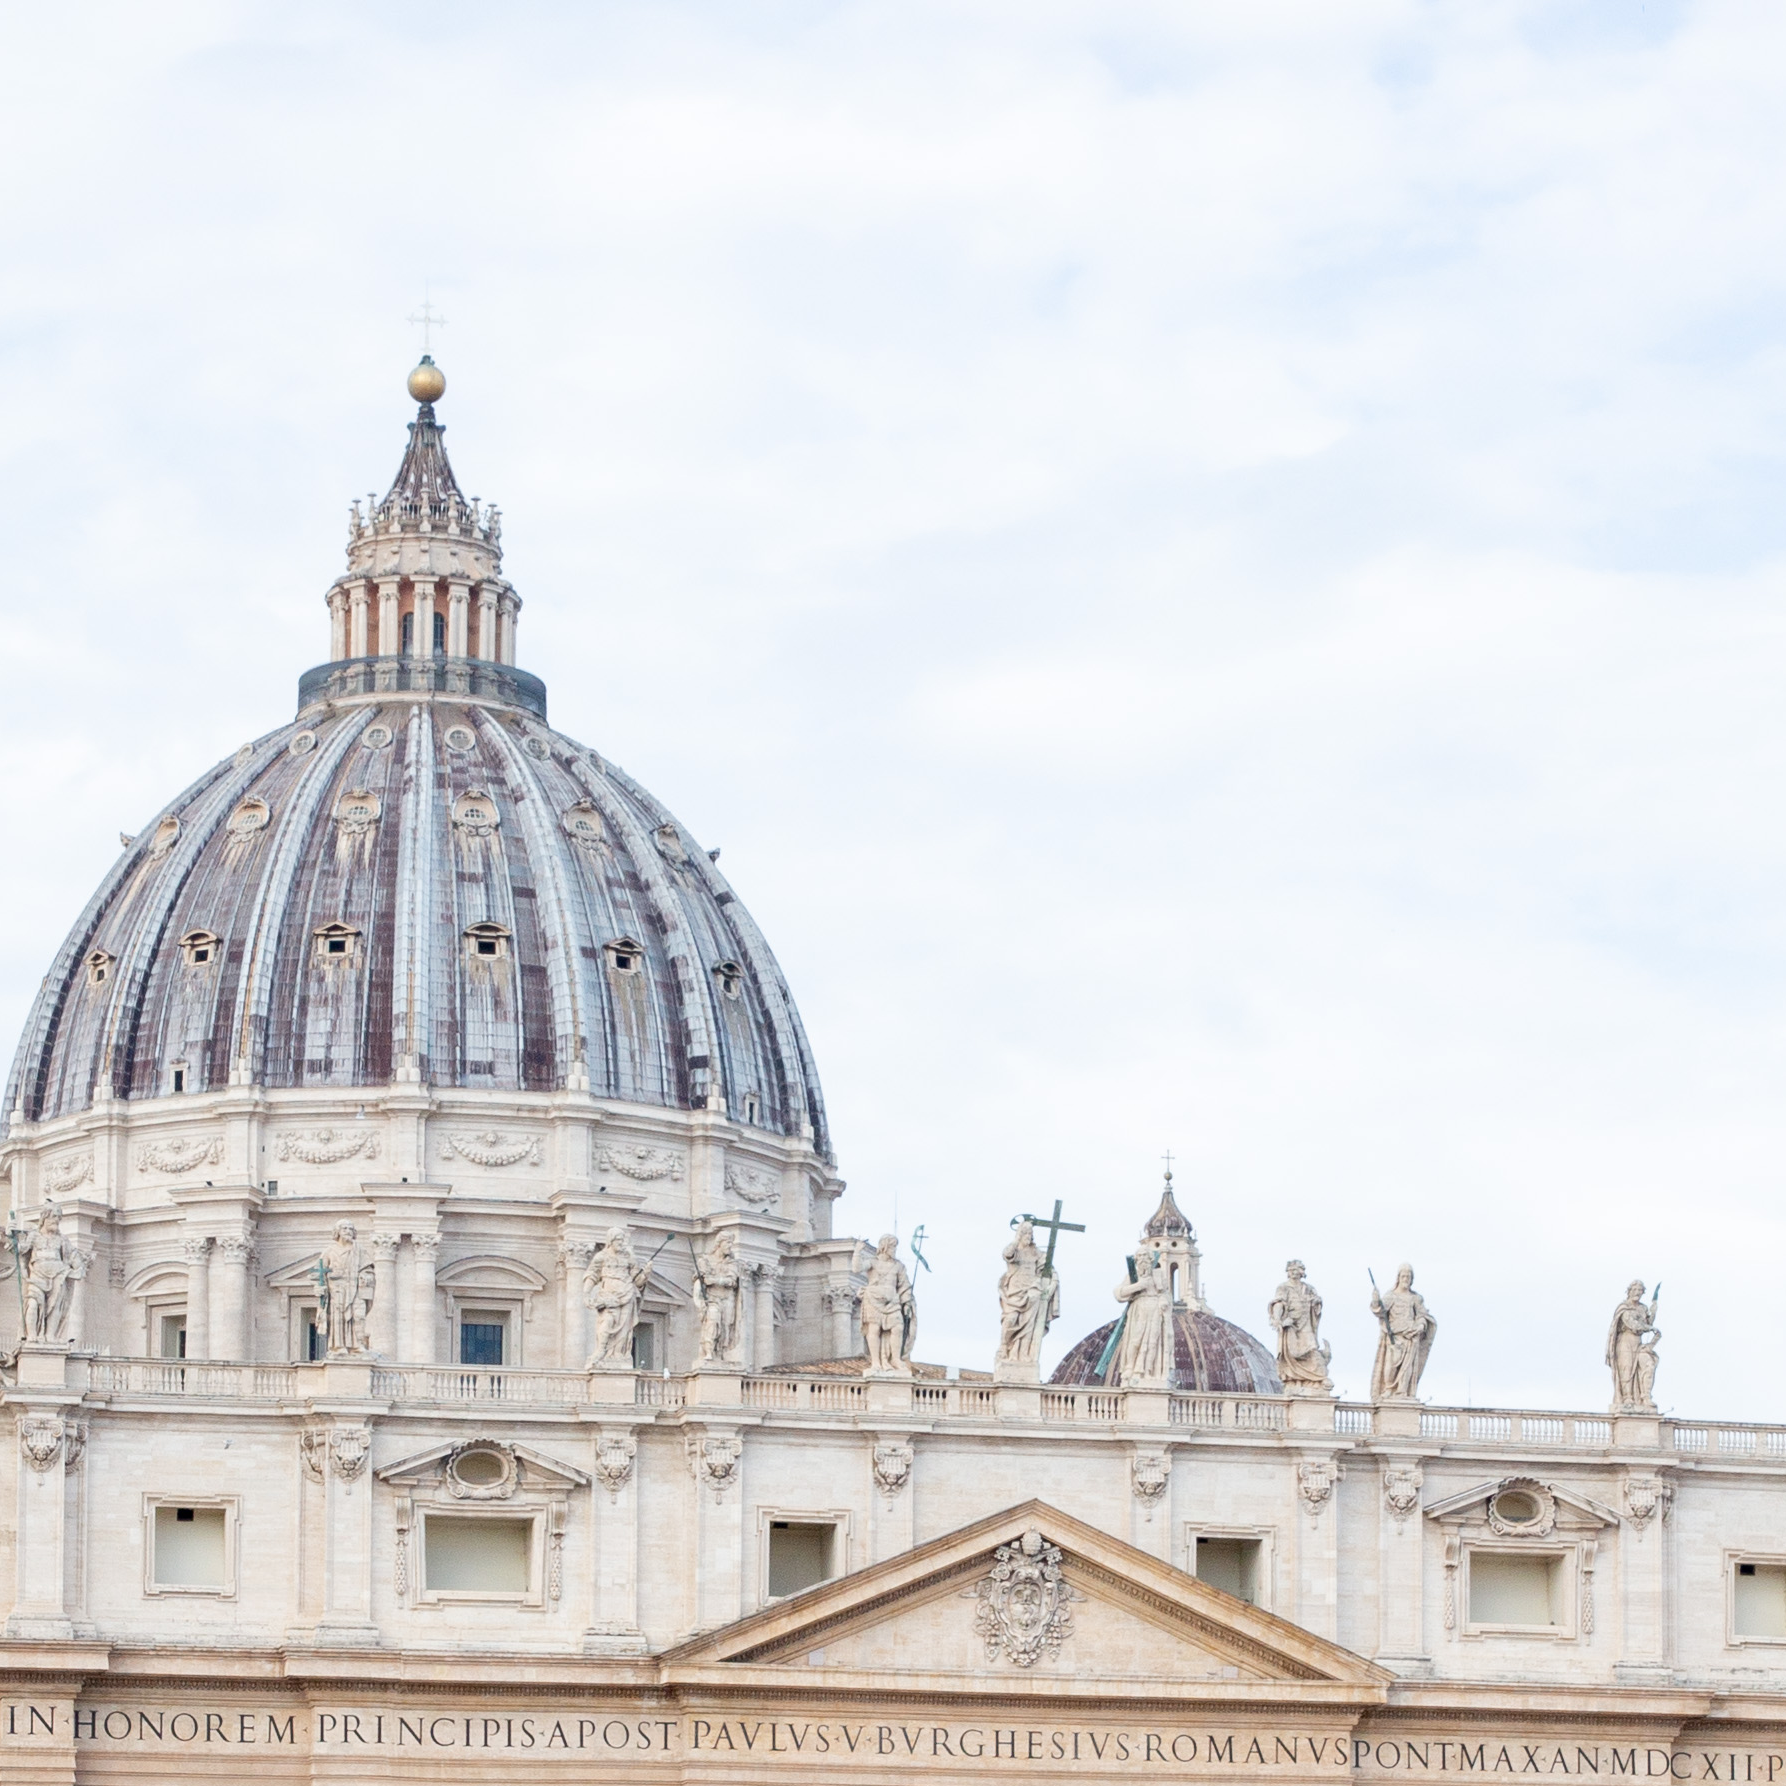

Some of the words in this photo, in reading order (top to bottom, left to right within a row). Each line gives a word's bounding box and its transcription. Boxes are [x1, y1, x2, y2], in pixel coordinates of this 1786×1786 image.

[7, 1705, 56, 1736] IN
[74, 1709, 296, 1745] HONOREM
[318, 1714, 538, 1750] PRINCIPIS
[547, 1720, 680, 1752] APOST
[692, 1721, 833, 1754] PAVLVS
[839, 1725, 865, 1754] V
[878, 1726, 1132, 1763] BVRGHESIVS
[1145, 1734, 1348, 1767] ROMANVS
[1352, 1739, 1457, 1772] PONT
[1459, 1743, 1542, 1775] MAX
[1550, 1747, 1602, 1776] AN
[1611, 1747, 1753, 1782] MDCXII
